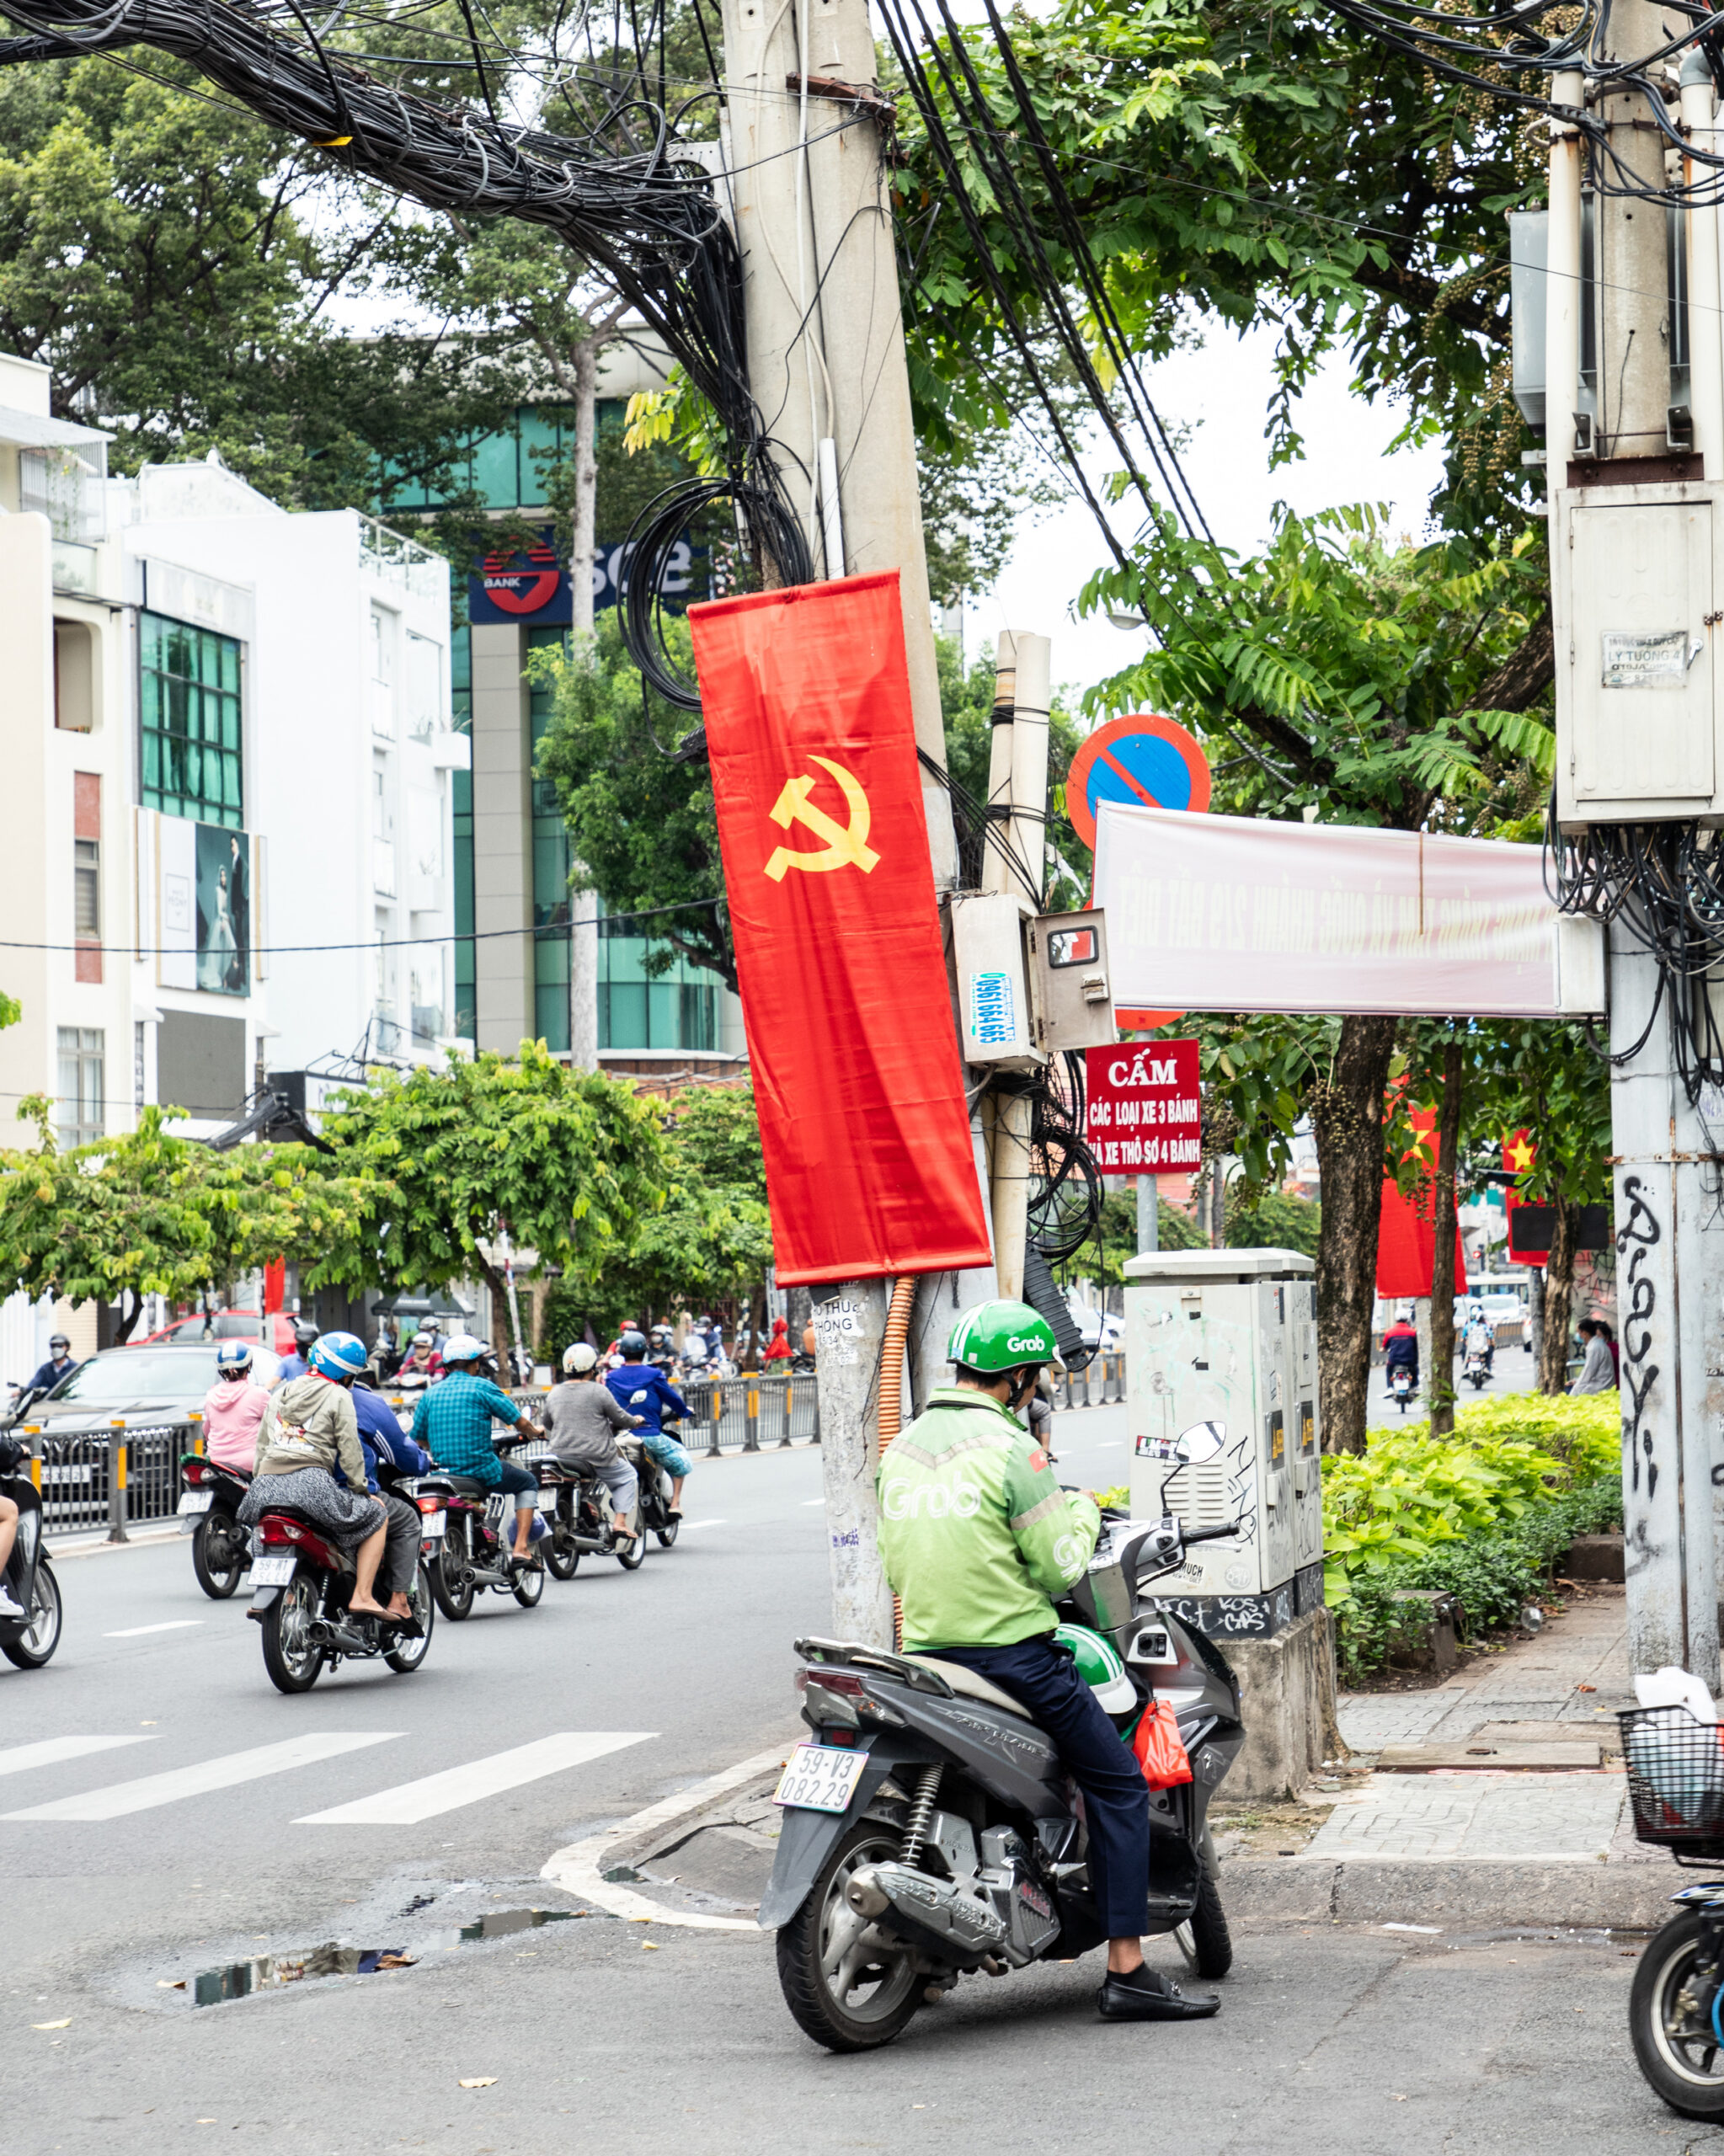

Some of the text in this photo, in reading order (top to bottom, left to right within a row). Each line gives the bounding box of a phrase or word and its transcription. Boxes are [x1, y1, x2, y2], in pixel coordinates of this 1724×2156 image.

[483, 576, 521, 589] BANK
[1108, 1048, 1177, 1086] CẤM
[1090, 1092, 1198, 1132] CÁC LOẠI XE 3 BÁNH
[1104, 1141, 1119, 1165] XE
[1120, 1134, 1142, 1165] THÔ
[1161, 1140, 1168, 1163] 4
[1169, 1133, 1200, 1164] BÁNH
[1006, 1333, 1046, 1353] Grab
[883, 1470, 981, 1521] Grab
[798, 1749, 855, 1779] 59-V3
[781, 1776, 849, 1807] 082.29
